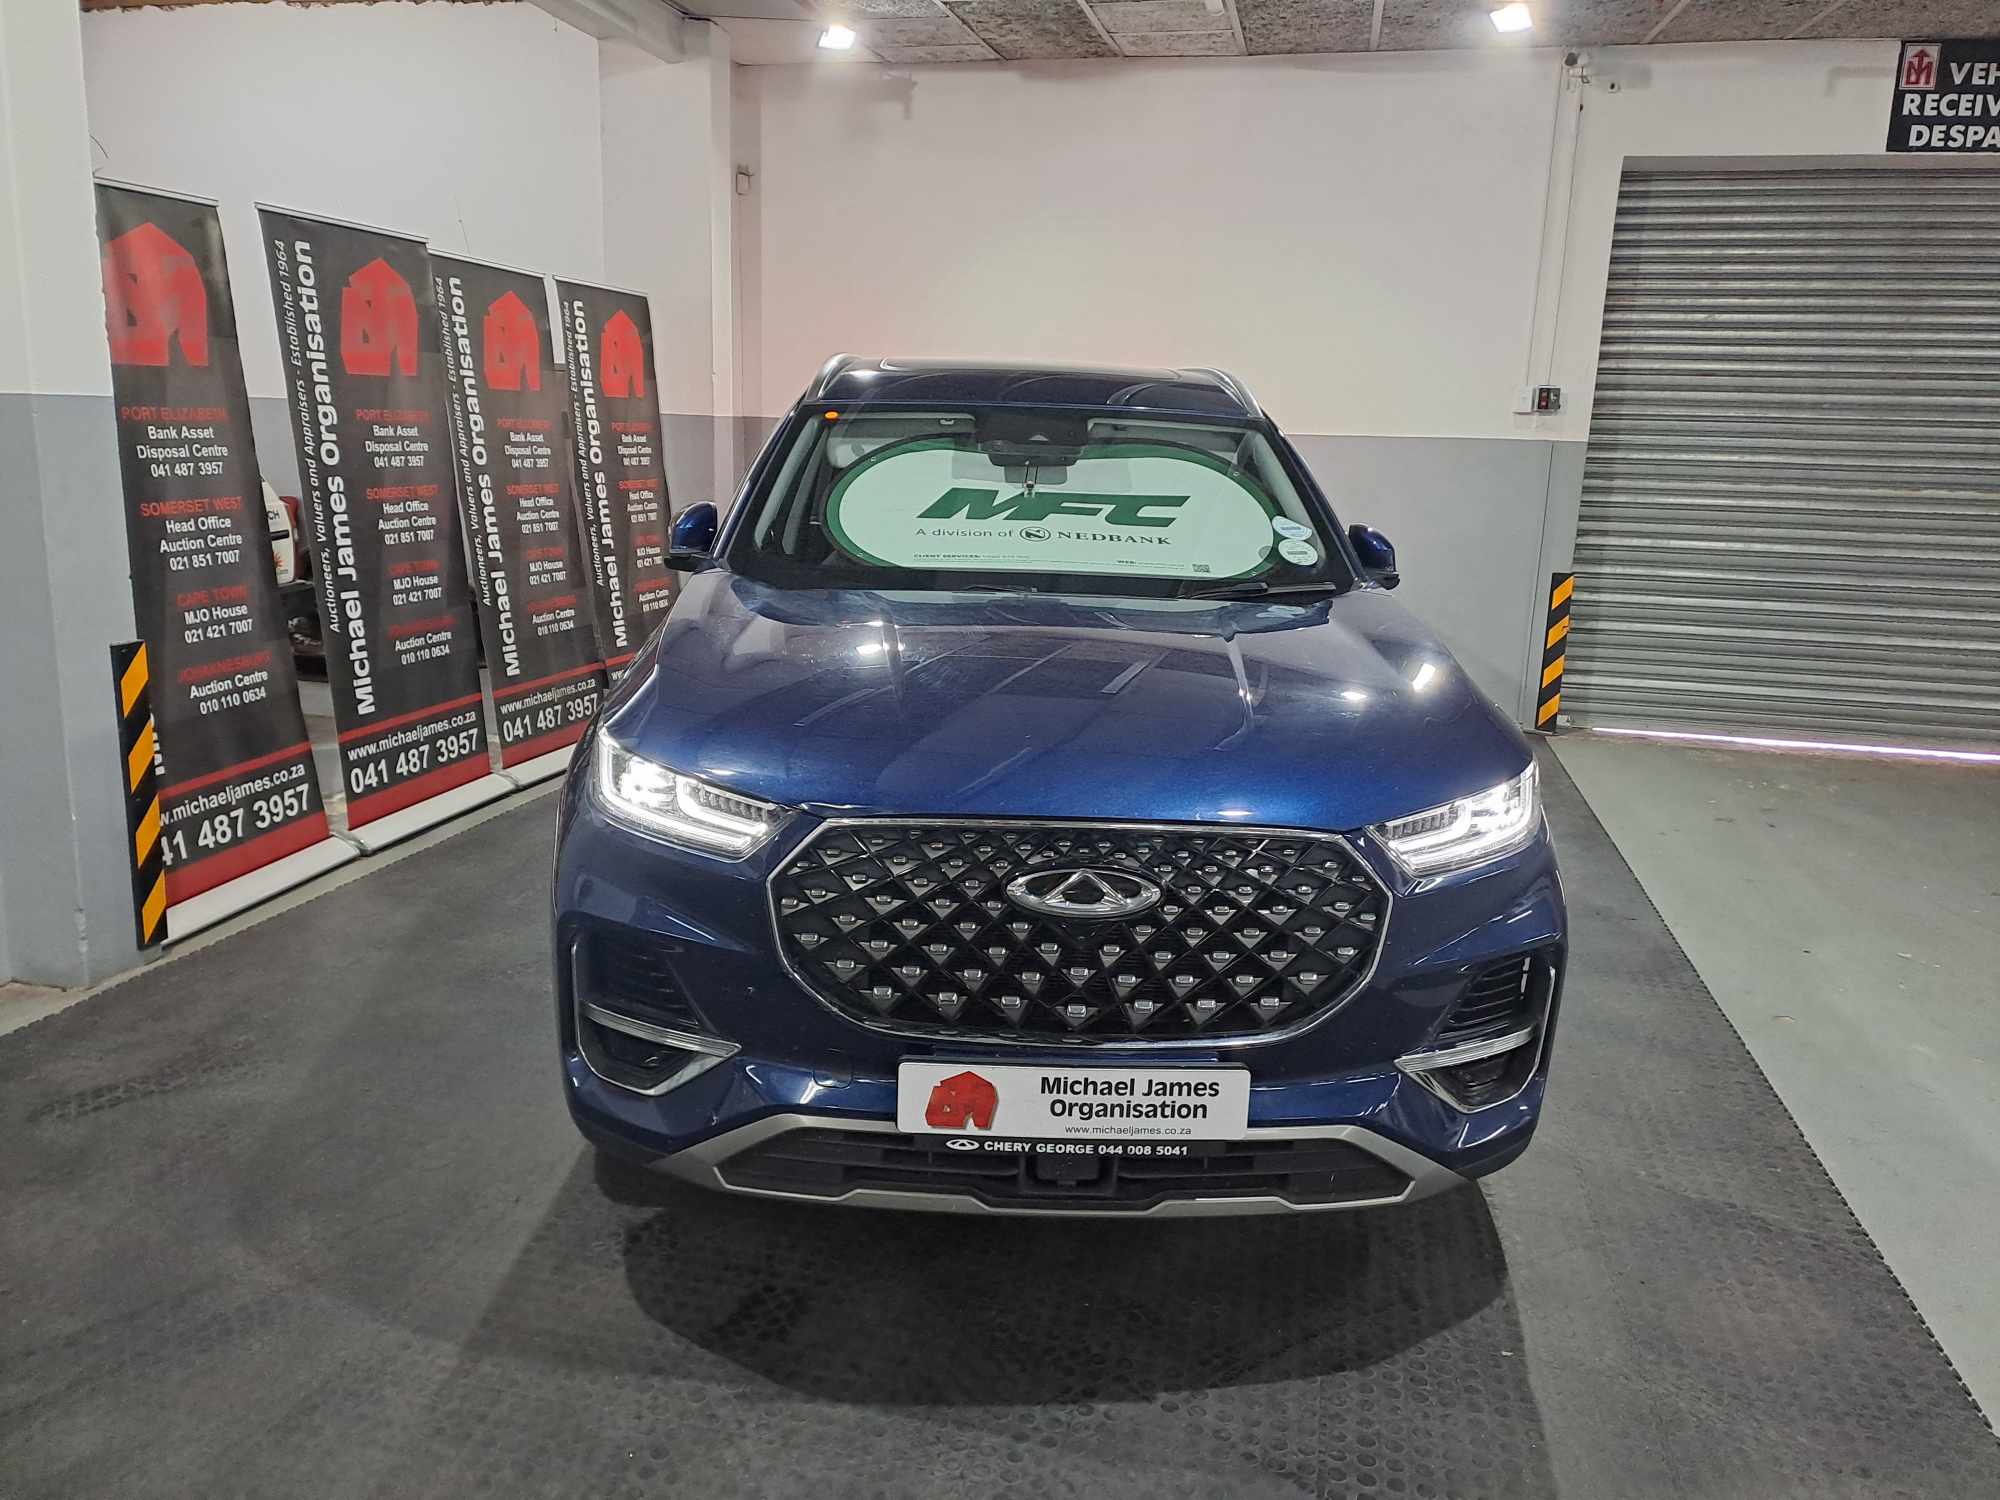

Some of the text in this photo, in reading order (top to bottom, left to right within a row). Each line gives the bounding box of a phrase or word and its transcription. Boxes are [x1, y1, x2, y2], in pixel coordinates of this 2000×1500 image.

[1902, 93, 2000, 116] RECEIV
[1908, 125, 2000, 147] DESPA
[439, 310, 456, 382] Established
[573, 300, 603, 465] Organisation
[121, 407, 157, 421] PORT
[452, 393, 468, 457] Appraisers
[147, 425, 214, 439] Bank Asset
[274, 239, 340, 632] Auctioneers, Valuers and Appraisers Established 1964
[373, 425, 418, 436] Bank Asset
[136, 444, 228, 461] Disposal Centre
[365, 441, 429, 454] Disposal Centre
[150, 461, 223, 477] 041 487 3957
[374, 456, 424, 468] 041 487 3957
[461, 458, 472, 483] and
[579, 459, 590, 480] and
[294, 240, 376, 716] Michael James Organisation
[449, 277, 520, 676] Michael James Organisation
[140, 496, 242, 517] SOMERSET WEST
[383, 501, 429, 514] Head Office
[467, 486, 479, 529] Valuers
[584, 482, 595, 521] Valuers
[594, 471, 614, 549] James
[916, 487, 1191, 527] MFC
[165, 516, 231, 533] Head Office
[378, 516, 436, 530] Auction Centre
[160, 533, 243, 553] Auction Centre
[384, 530, 434, 545] 021 851 7007
[916, 528, 1172, 545] A division of NEDBANK
[170, 550, 240, 571] 021 851 7007
[475, 535, 491, 606] Auctioneers,
[393, 576, 438, 590] MJO House
[393, 587, 442, 606] 021 421 7007
[603, 556, 628, 648] Michael
[184, 604, 248, 625] MJO House
[184, 619, 253, 643] 021 421 7007
[395, 630, 452, 651] Auction Centre
[401, 644, 450, 665] 010 110 0634
[190, 671, 268, 699] Auction Centre
[200, 686, 266, 715] 010 110 0634
[500, 678, 596, 715] www.michaeljames.co.za
[503, 693, 598, 742] 041 487 3957
[347, 711, 476, 761] www.michaeljames.co.za
[350, 728, 478, 794] 041 487 3957
[198, 808, 244, 850] 487
[252, 783, 309, 829] 3957
[1040, 1076, 1220, 1098] Michael James
[1050, 1099, 1208, 1121] Organisation
[1065, 1124, 1192, 1136] www.michaeljames.co.za
[984, 1141, 1188, 1156] CHERY GEORGE 044 008 5041
